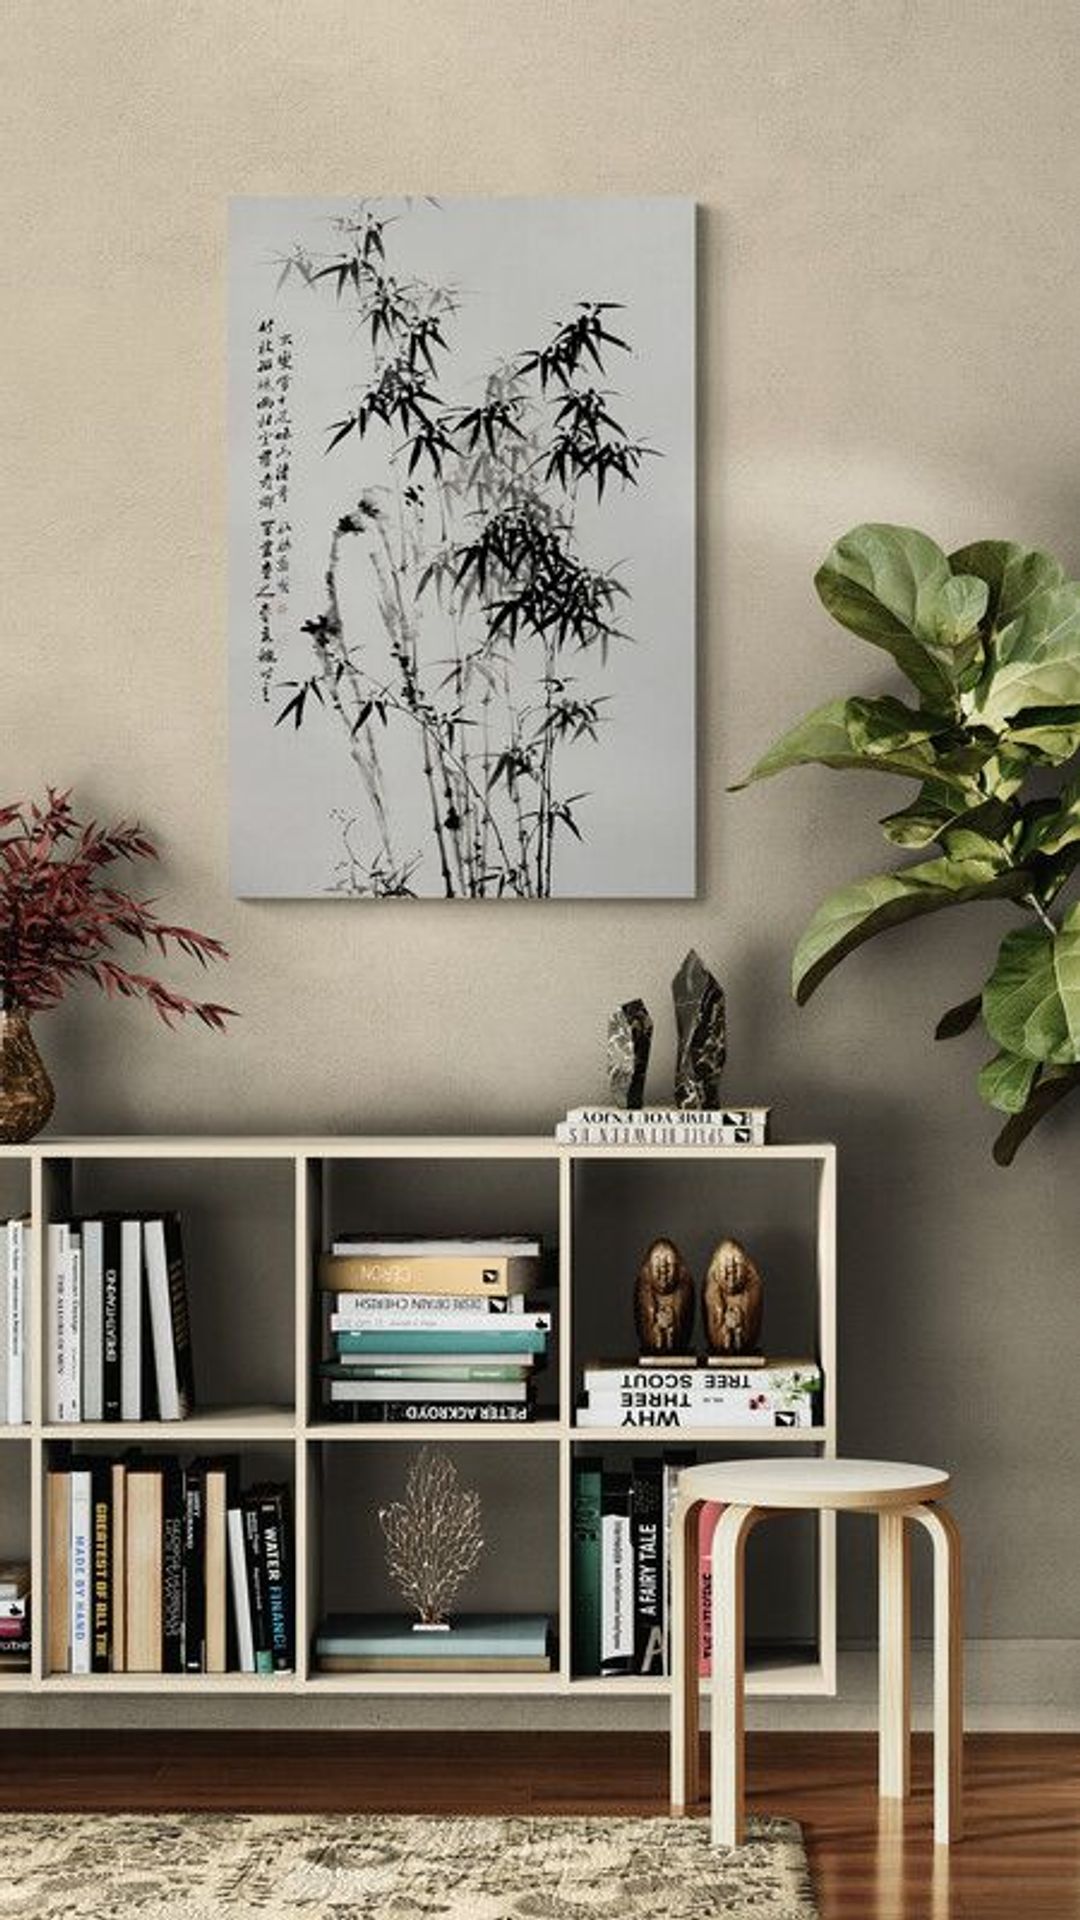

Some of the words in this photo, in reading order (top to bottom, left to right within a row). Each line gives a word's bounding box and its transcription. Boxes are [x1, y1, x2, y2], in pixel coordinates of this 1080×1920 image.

[580, 1111, 634, 1124] ENJOY
[638, 1111, 672, 1124] YOU
[678, 1111, 713, 1124] TIME
[354, 1297, 409, 1312] CHERISH
[620, 1375, 692, 1389] SCOUT
[705, 1375, 751, 1389] TREE
[620, 1393, 692, 1408] THREE
[405, 1406, 477, 1420] ACKROYD
[480, 1405, 528, 1420] PETER
[620, 1411, 680, 1427] WHY
[95, 1502, 108, 1578] GREATEST
[639, 1524, 657, 1561] TALE
[75, 1535, 85, 1574] MADE
[264, 1525, 280, 1581] WATER
[75, 1579, 85, 1598] BY
[95, 1580, 108, 1598] OF
[639, 1564, 657, 1602] FAIRY
[95, 1602, 108, 1629] ALL
[639, 1605, 657, 1616] A
[75, 1601, 85, 1641] HAND
